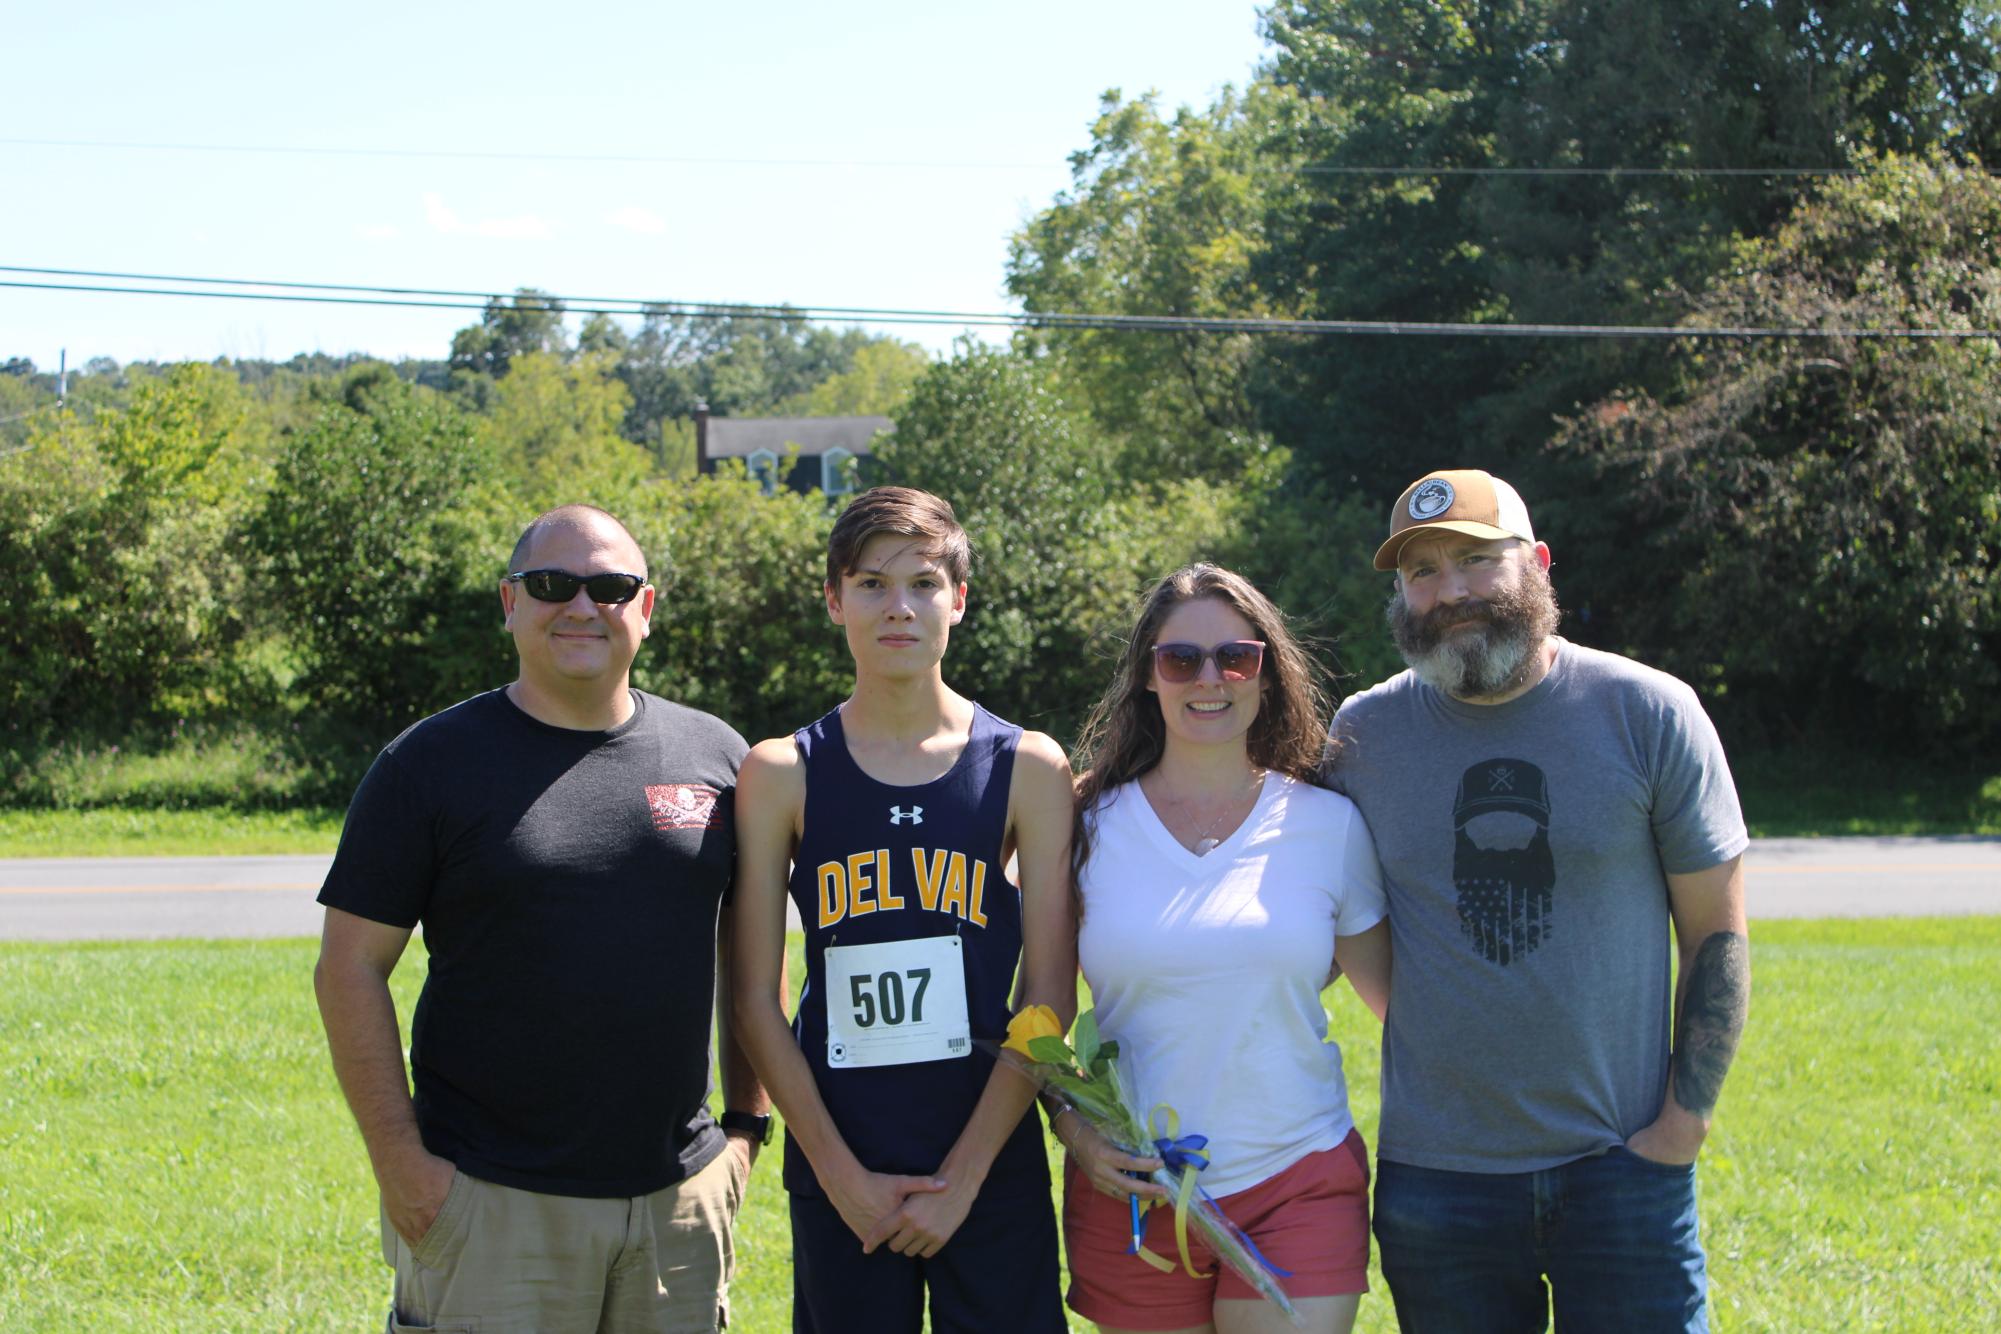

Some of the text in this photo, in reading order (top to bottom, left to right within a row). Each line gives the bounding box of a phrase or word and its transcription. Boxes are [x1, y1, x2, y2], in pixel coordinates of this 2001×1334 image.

[817, 847, 988, 929] DEL VAL
[850, 968, 931, 1028] 507
